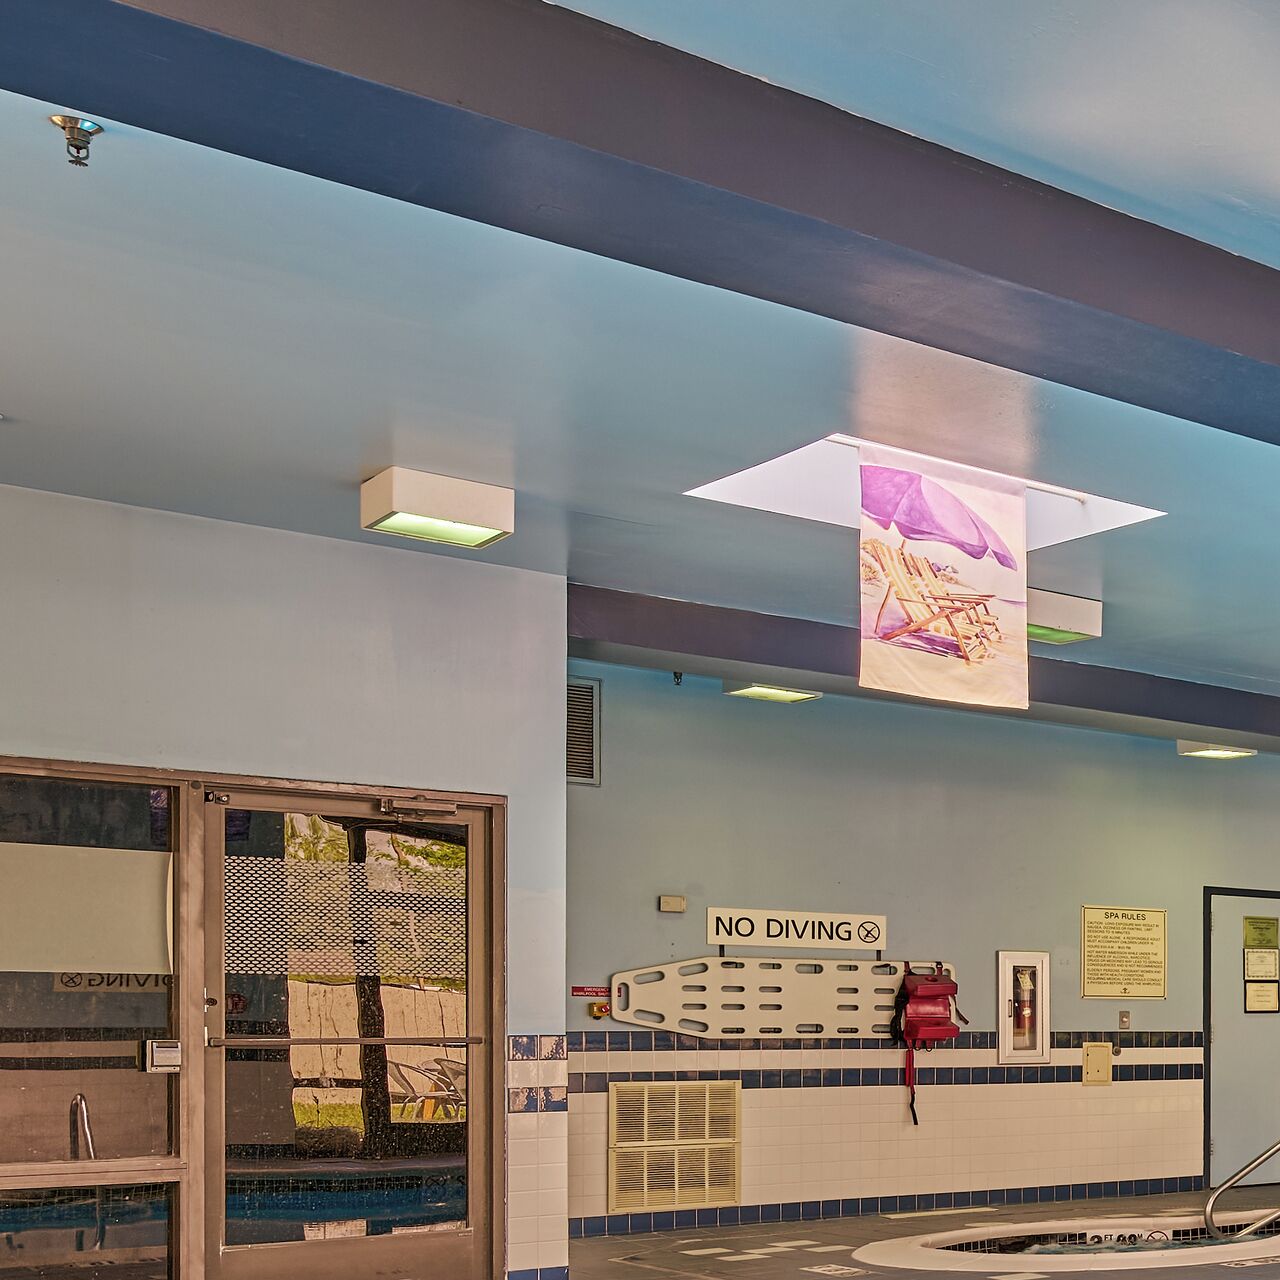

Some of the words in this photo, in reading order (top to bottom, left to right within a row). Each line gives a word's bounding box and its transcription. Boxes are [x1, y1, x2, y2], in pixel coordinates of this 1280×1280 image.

[1105, 912, 1119, 920] SPA
[1122, 913, 1146, 921] RULES
[715, 916, 755, 937] NO
[766, 918, 852, 941] DIVING
